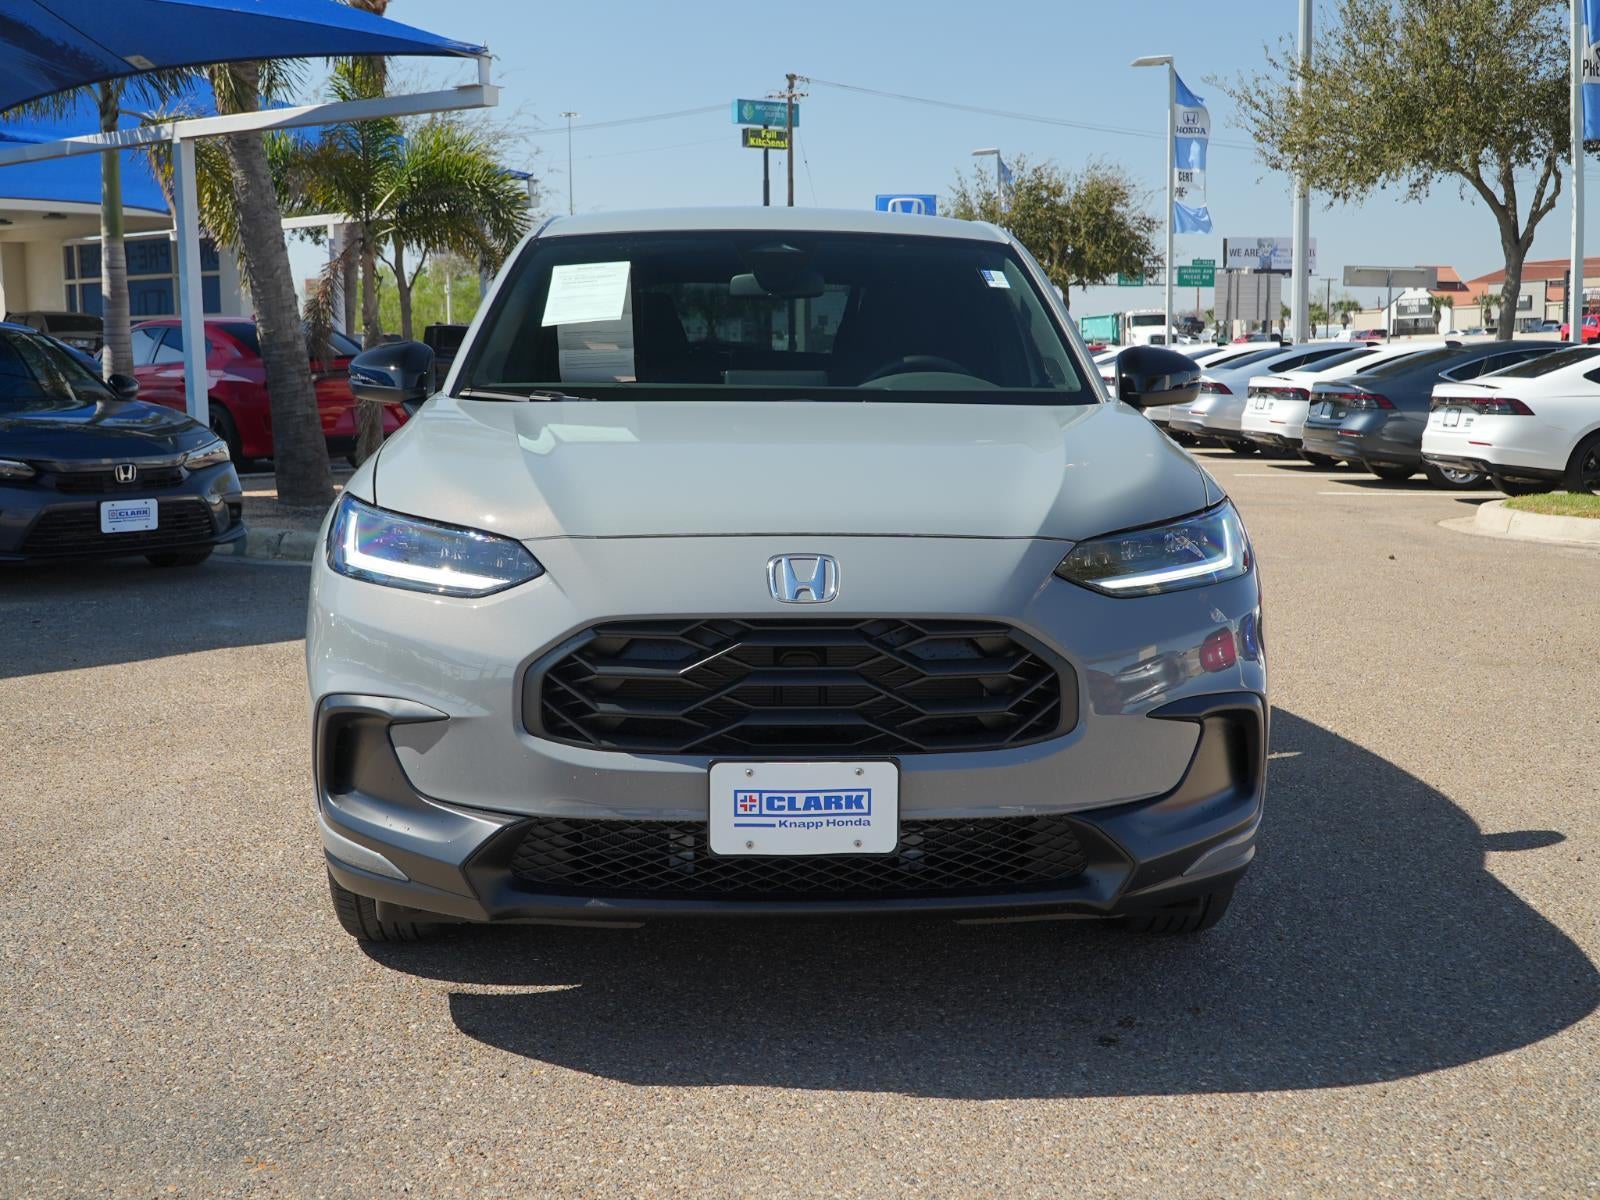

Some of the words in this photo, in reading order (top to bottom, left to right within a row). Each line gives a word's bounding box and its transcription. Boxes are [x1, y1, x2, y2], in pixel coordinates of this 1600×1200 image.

[761, 130, 777, 139] Full
[1176, 125, 1206, 134] HONDA
[1178, 171, 1193, 183] CERT
[1229, 248, 1242, 257] WE
[1243, 248, 1260, 257] ARE
[766, 794, 865, 812] CLARK
[778, 819, 823, 830] Knapp
[826, 818, 871, 828] Honda
